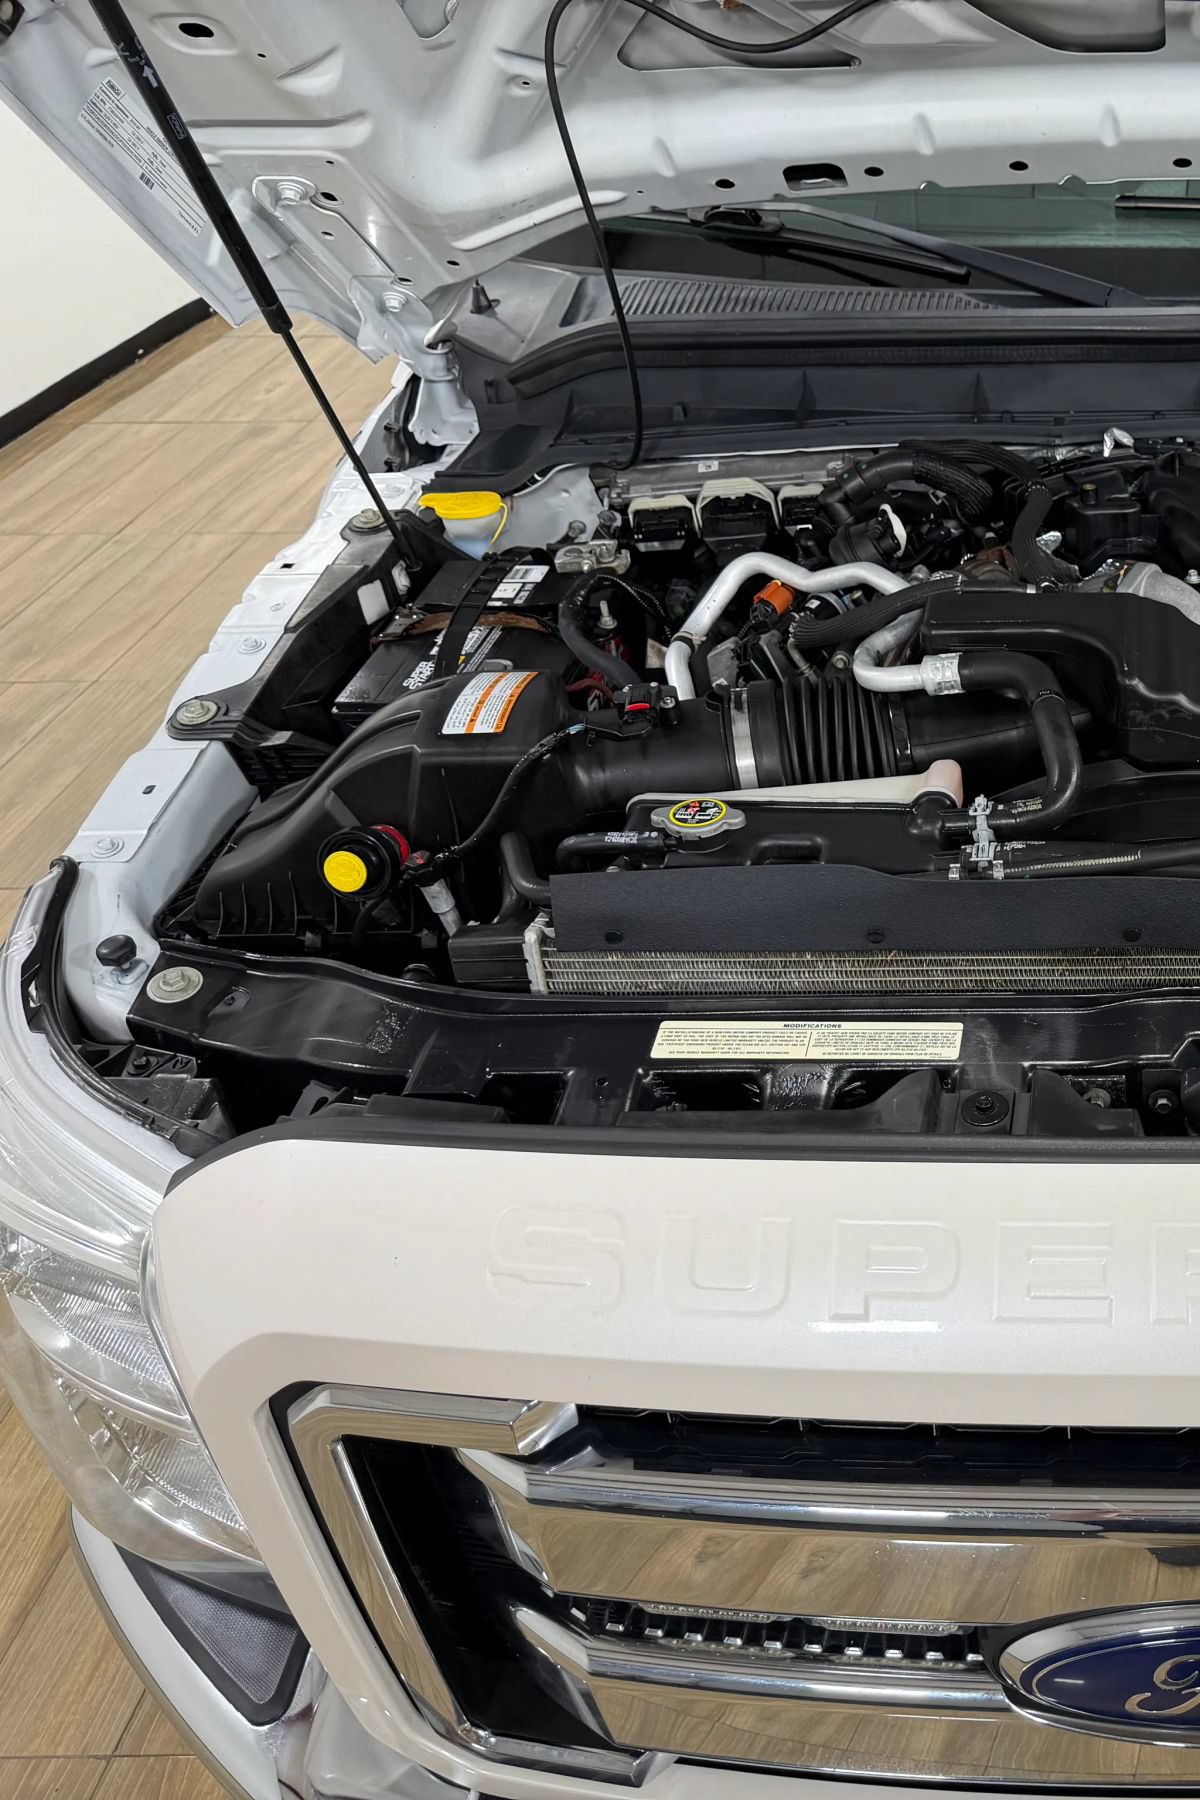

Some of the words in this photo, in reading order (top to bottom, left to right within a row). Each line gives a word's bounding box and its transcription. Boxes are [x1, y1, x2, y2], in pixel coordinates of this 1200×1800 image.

[168, 115, 187, 138] FoMoCo
[403, 660, 430, 688] SUPER
[409, 660, 437, 691] START
